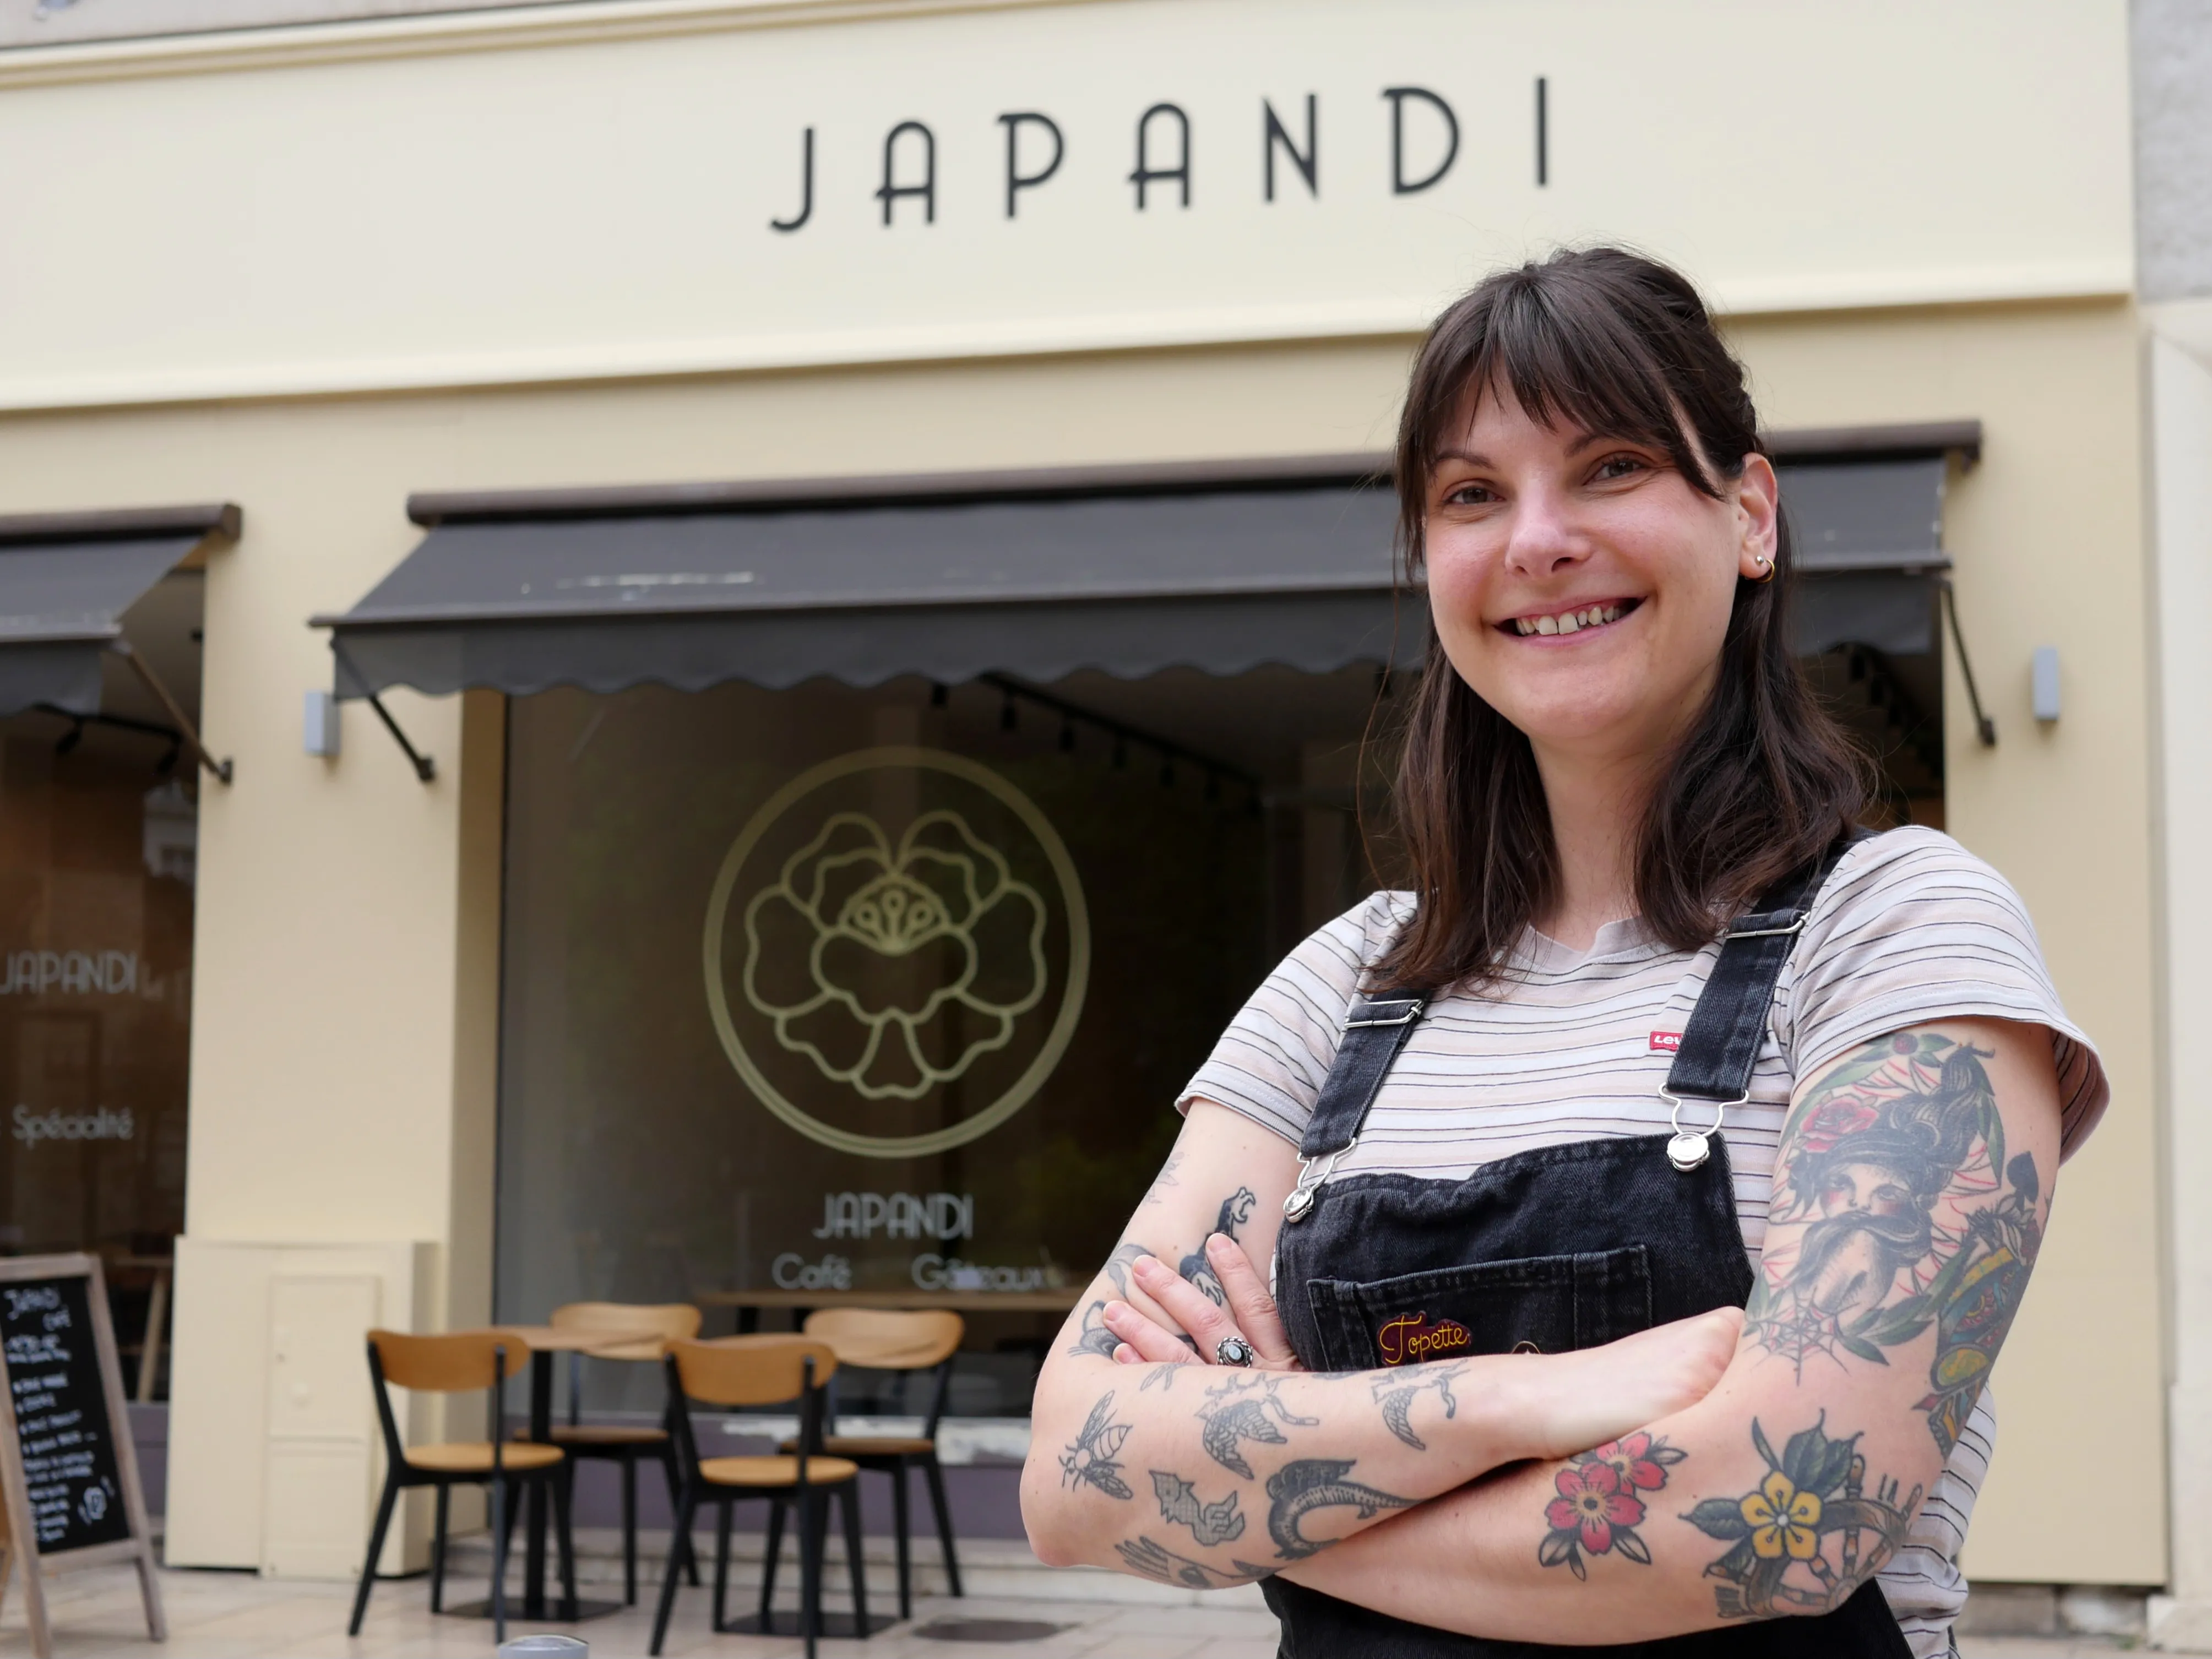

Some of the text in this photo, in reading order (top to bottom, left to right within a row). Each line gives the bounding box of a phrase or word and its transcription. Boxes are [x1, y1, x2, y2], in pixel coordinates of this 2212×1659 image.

[769, 76, 1548, 233] JAPANDI
[0, 949, 138, 994] JAPANDI
[812, 1192, 974, 1240] JAPANDI
[771, 1252, 851, 1290] Café
[1379, 1314, 1469, 1364] Topette
